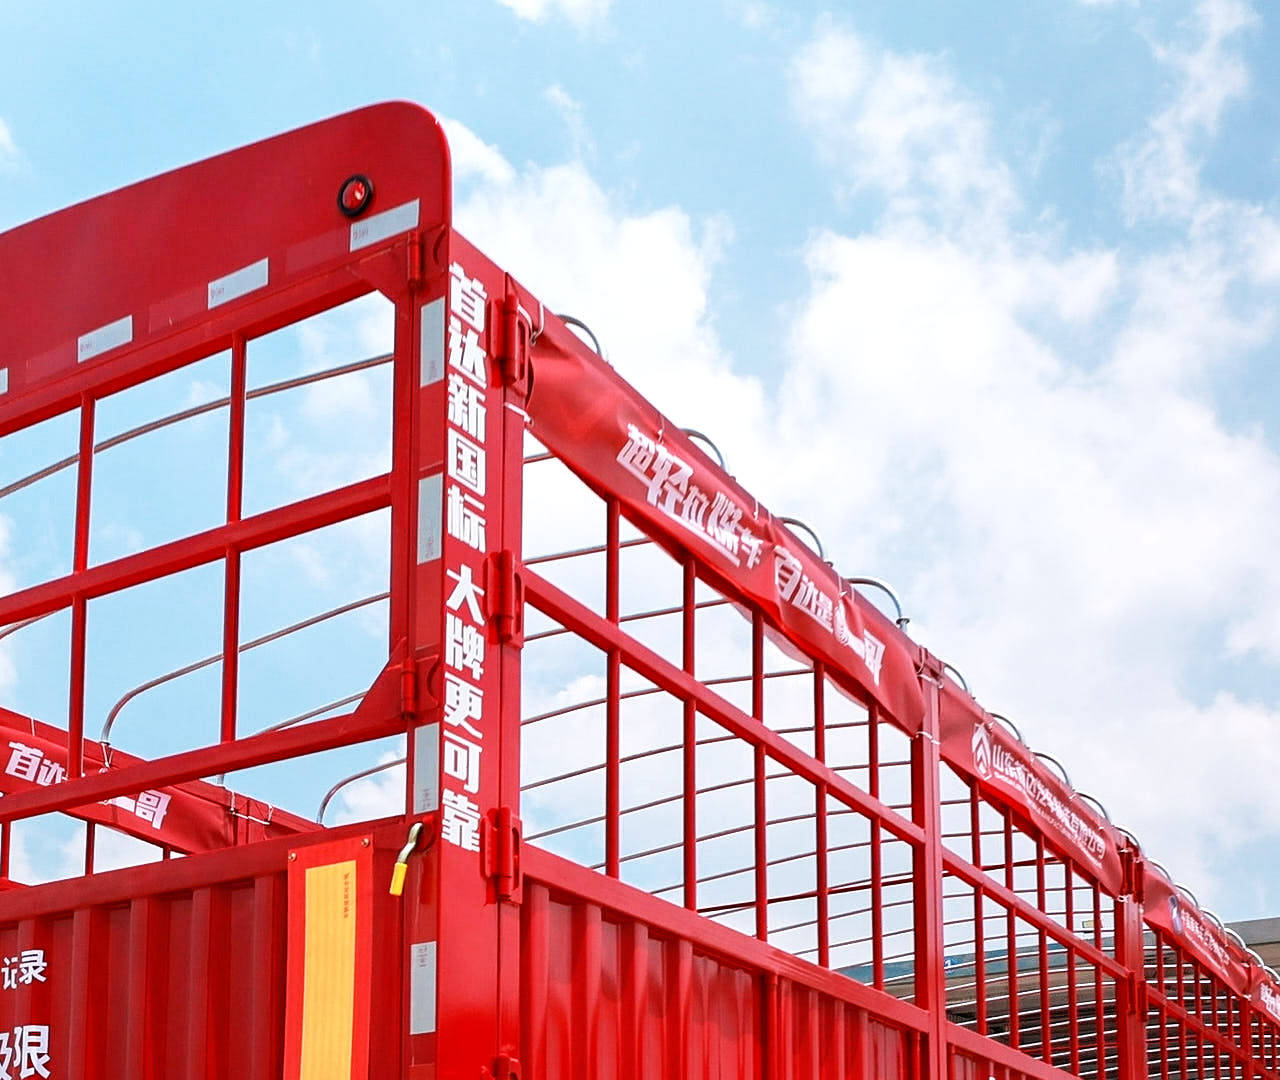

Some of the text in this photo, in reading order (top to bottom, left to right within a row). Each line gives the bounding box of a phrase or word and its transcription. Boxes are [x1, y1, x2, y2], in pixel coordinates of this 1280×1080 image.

[441, 261, 488, 853] 首达新国标 大牌更可靠
